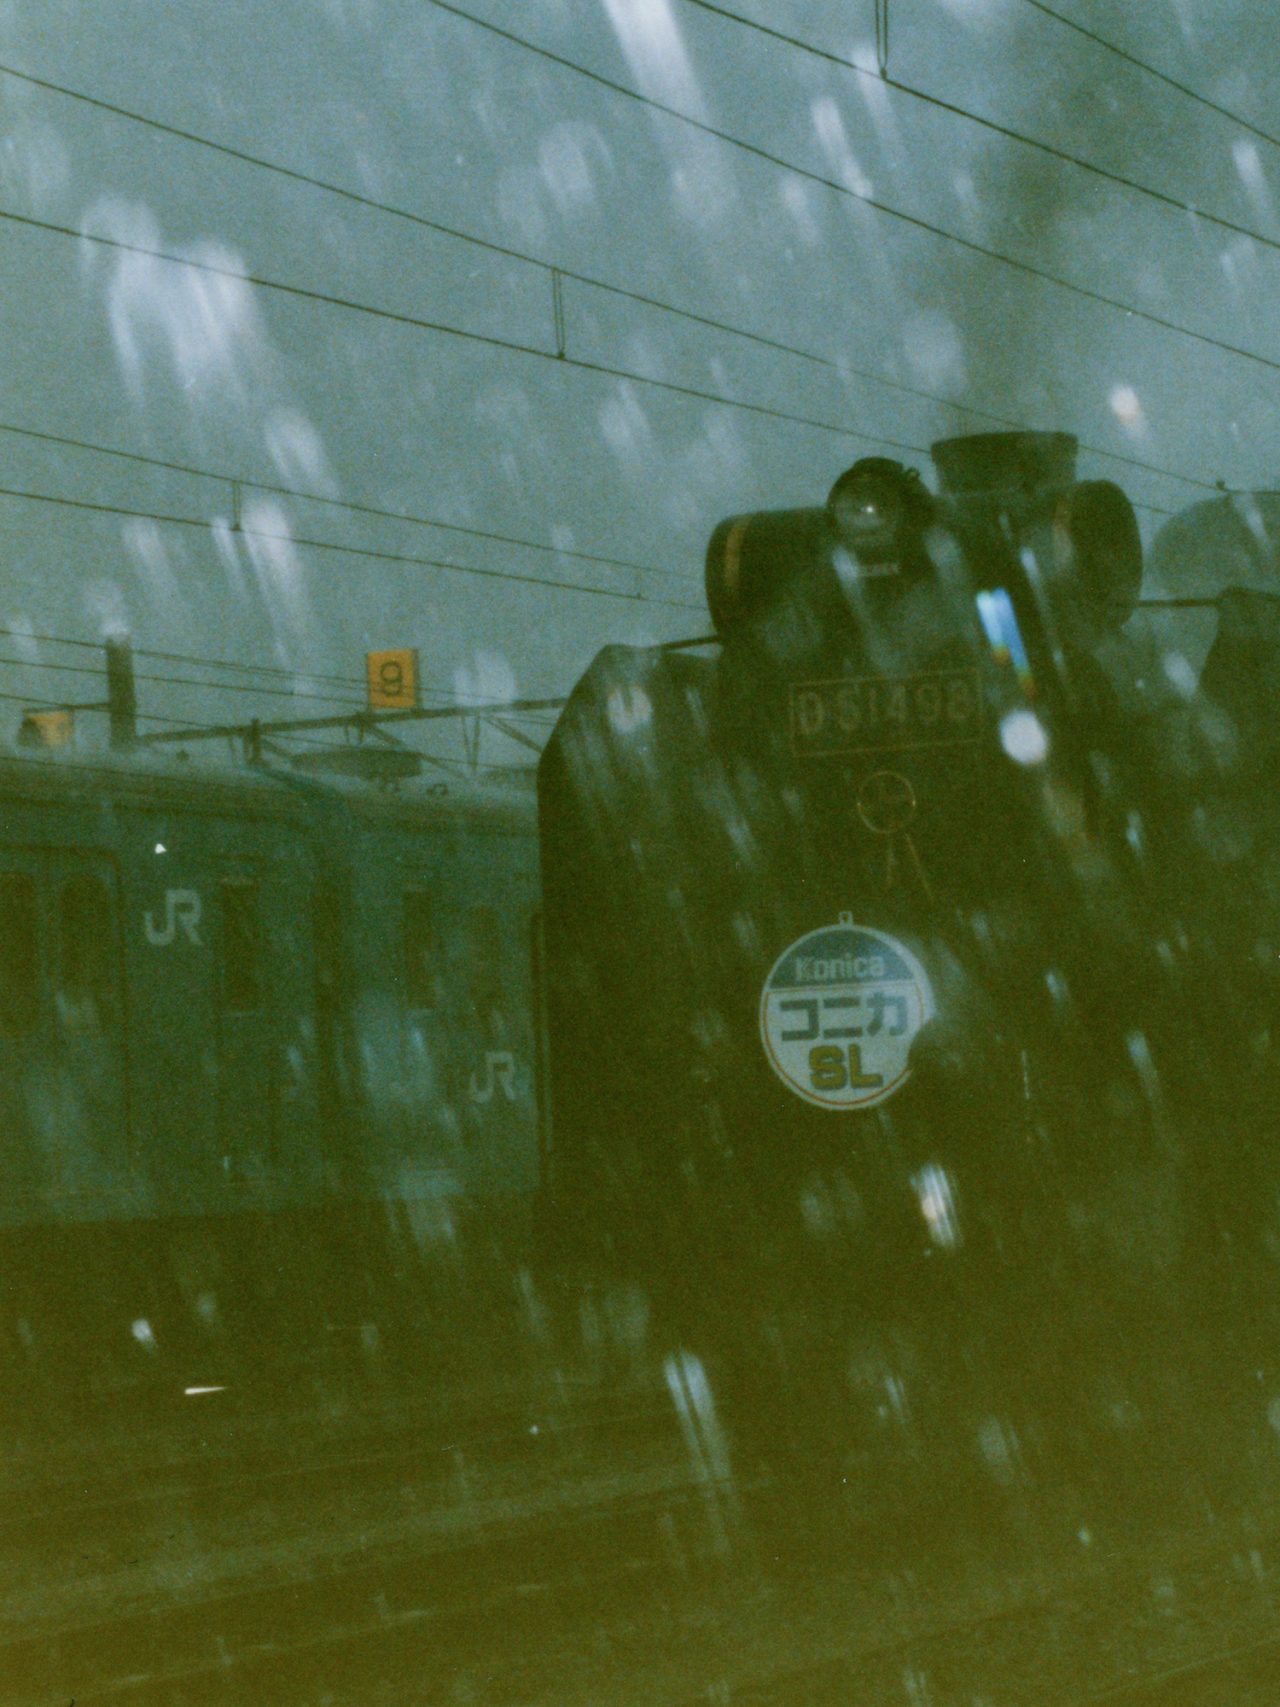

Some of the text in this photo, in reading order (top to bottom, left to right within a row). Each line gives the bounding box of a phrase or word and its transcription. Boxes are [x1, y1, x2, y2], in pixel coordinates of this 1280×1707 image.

[379, 660, 402, 697] 9
[798, 678, 971, 735] D51498
[144, 888, 202, 946] JR
[796, 953, 885, 982] Konica
[779, 991, 908, 1041] コニカ
[470, 1050, 516, 1102] JR
[809, 1044, 883, 1091] SL
